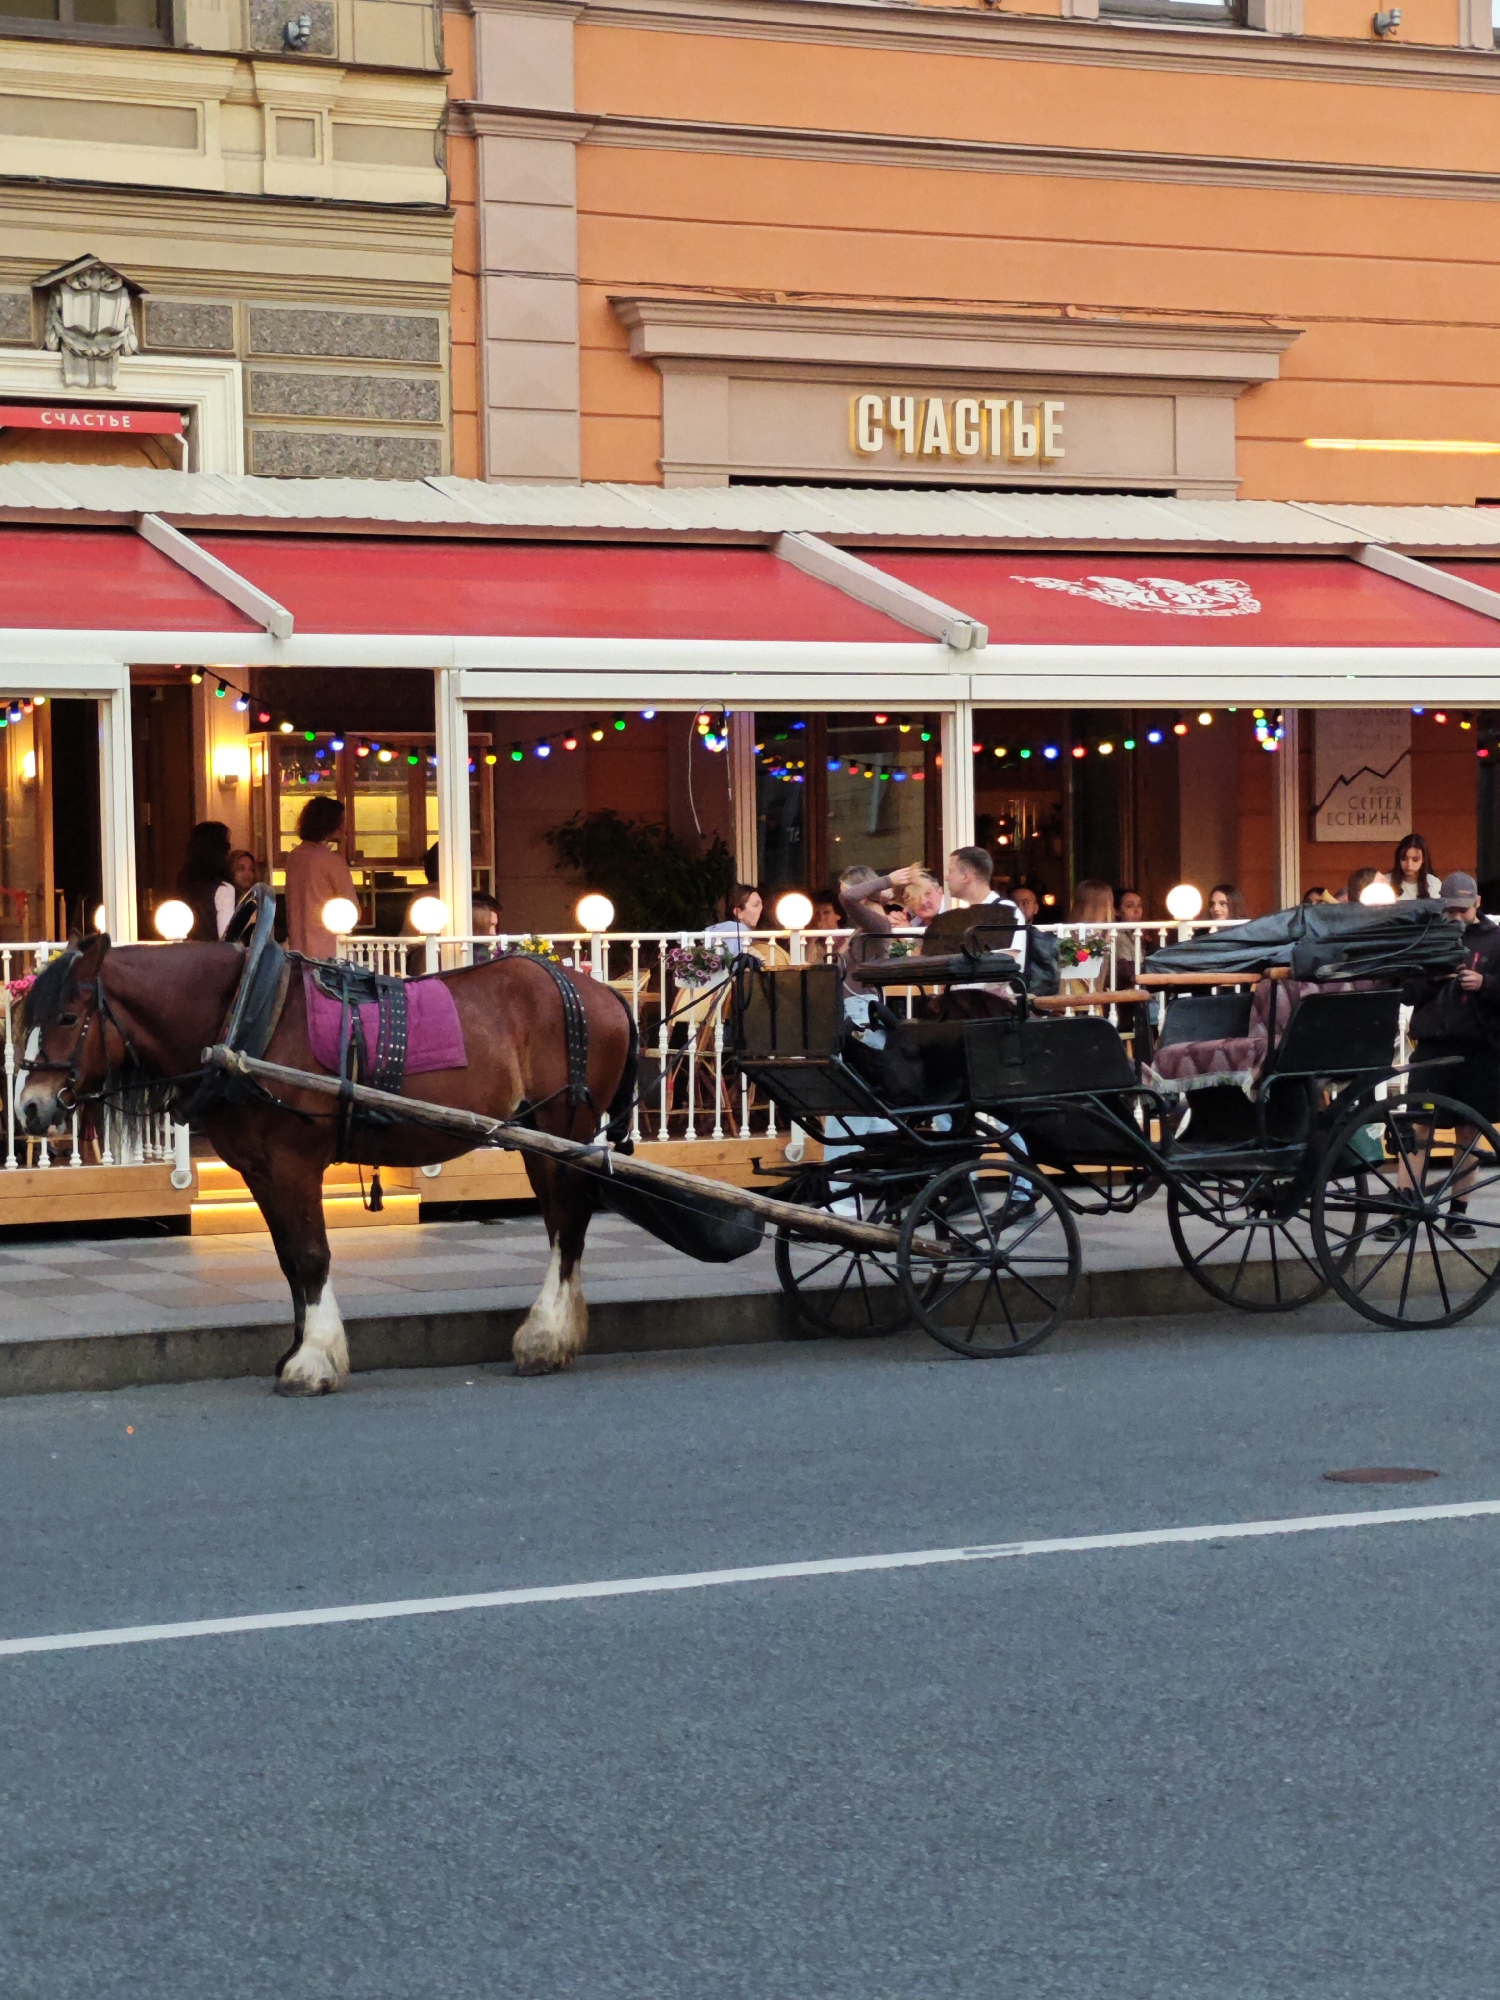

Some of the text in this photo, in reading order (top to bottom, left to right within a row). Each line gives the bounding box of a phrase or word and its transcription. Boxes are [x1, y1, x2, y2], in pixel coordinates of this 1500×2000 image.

[41, 412, 131, 428] СЧАСТЬЕ
[858, 394, 1066, 458] СЧАСТЬЕ
[1326, 812, 1401, 826] ЕСЕНИНА
